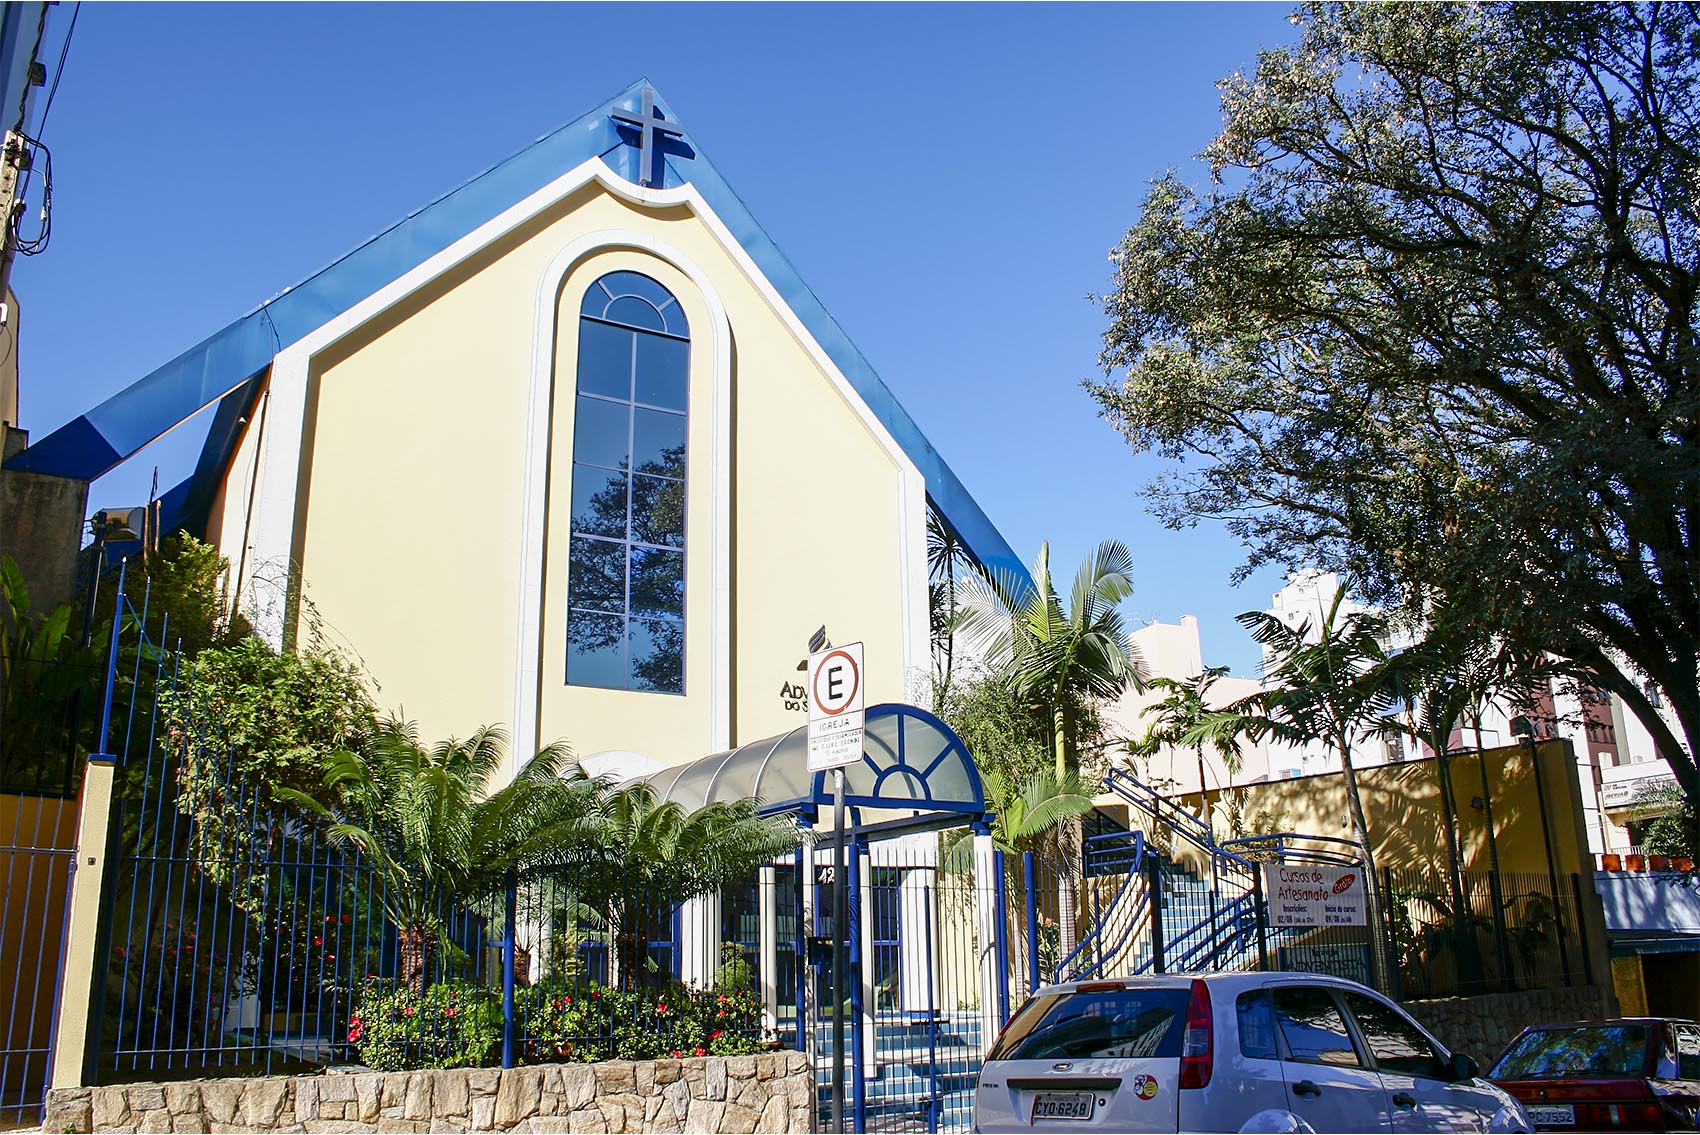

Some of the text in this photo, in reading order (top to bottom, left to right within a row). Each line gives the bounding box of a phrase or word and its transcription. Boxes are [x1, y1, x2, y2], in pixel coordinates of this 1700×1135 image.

[828, 666, 843, 700] E
[819, 718, 850, 732] IGREJA
[1311, 869, 1324, 885] de
[1278, 885, 1329, 902] Artesanato
[1288, 957, 1366, 973] ADVENTISTA
